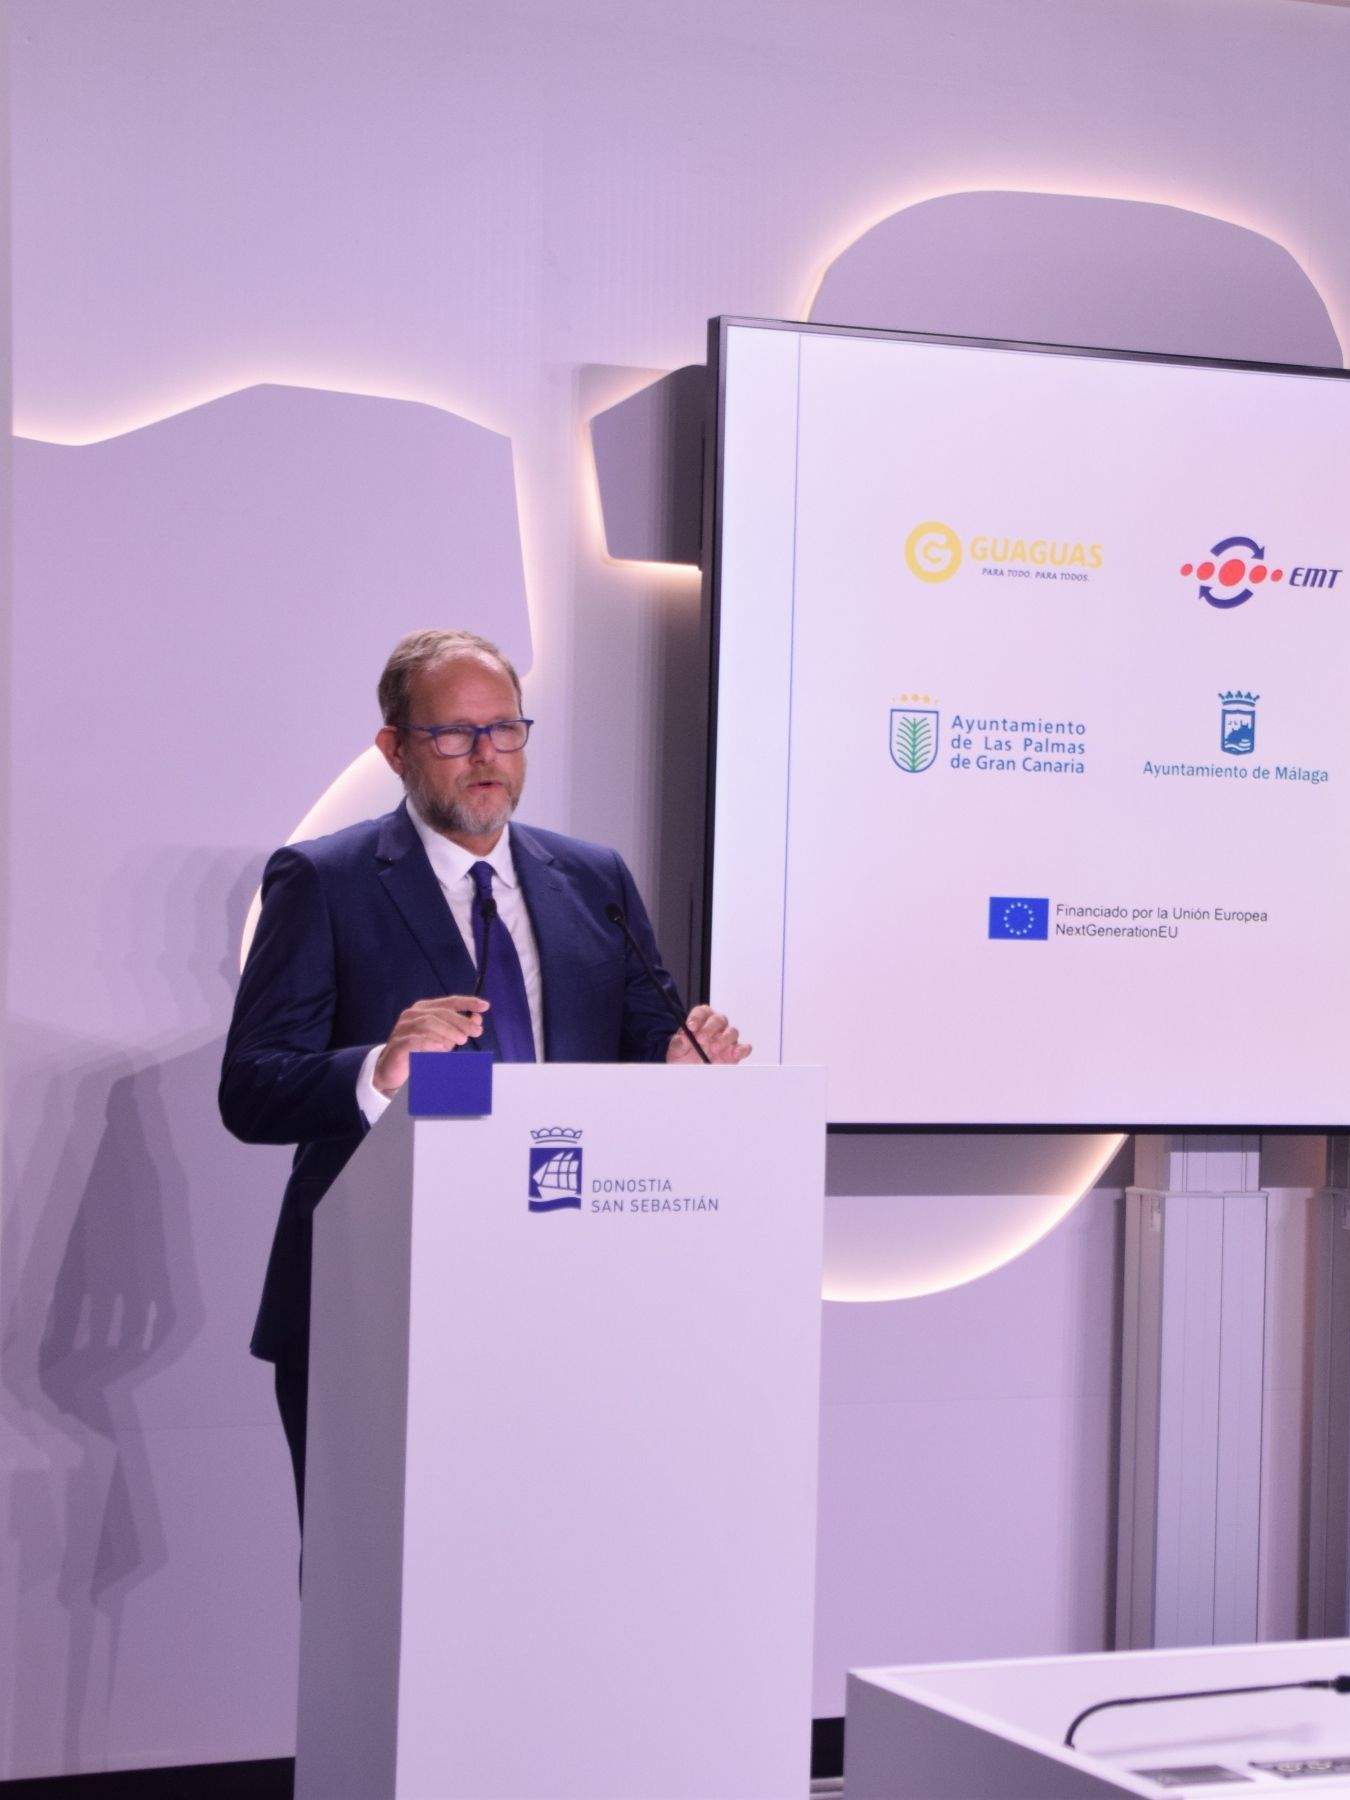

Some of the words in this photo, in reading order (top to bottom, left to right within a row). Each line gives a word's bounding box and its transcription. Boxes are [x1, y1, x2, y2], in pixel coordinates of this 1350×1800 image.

[968, 535, 1104, 569] GUAGUAS
[981, 567, 1005, 577] PARA
[1034, 571, 1058, 580] PARA
[1289, 567, 1343, 588] EMT
[951, 715, 1086, 735] Ayuntamiento
[951, 735, 972, 750] de
[984, 737, 1012, 751] Las
[1023, 738, 1086, 755] Palmas
[950, 755, 971, 769] de
[976, 756, 1016, 771] Gran
[1022, 757, 1085, 774] Canaria
[1143, 761, 1248, 779] Ayuntamiento
[1252, 766, 1270, 780] de
[1275, 765, 1329, 784] Málaga
[1056, 904, 1128, 919] Financiado
[1132, 908, 1153, 924] por
[1157, 907, 1168, 920] la
[1172, 907, 1210, 921] Unión
[1214, 908, 1268, 923] Europea
[1056, 924, 1178, 939] NextGenerationEU
[591, 1179, 673, 1194] DONOSTIA
[590, 1198, 624, 1214] SAN
[630, 1195, 719, 1213] SEBASTIÁN
